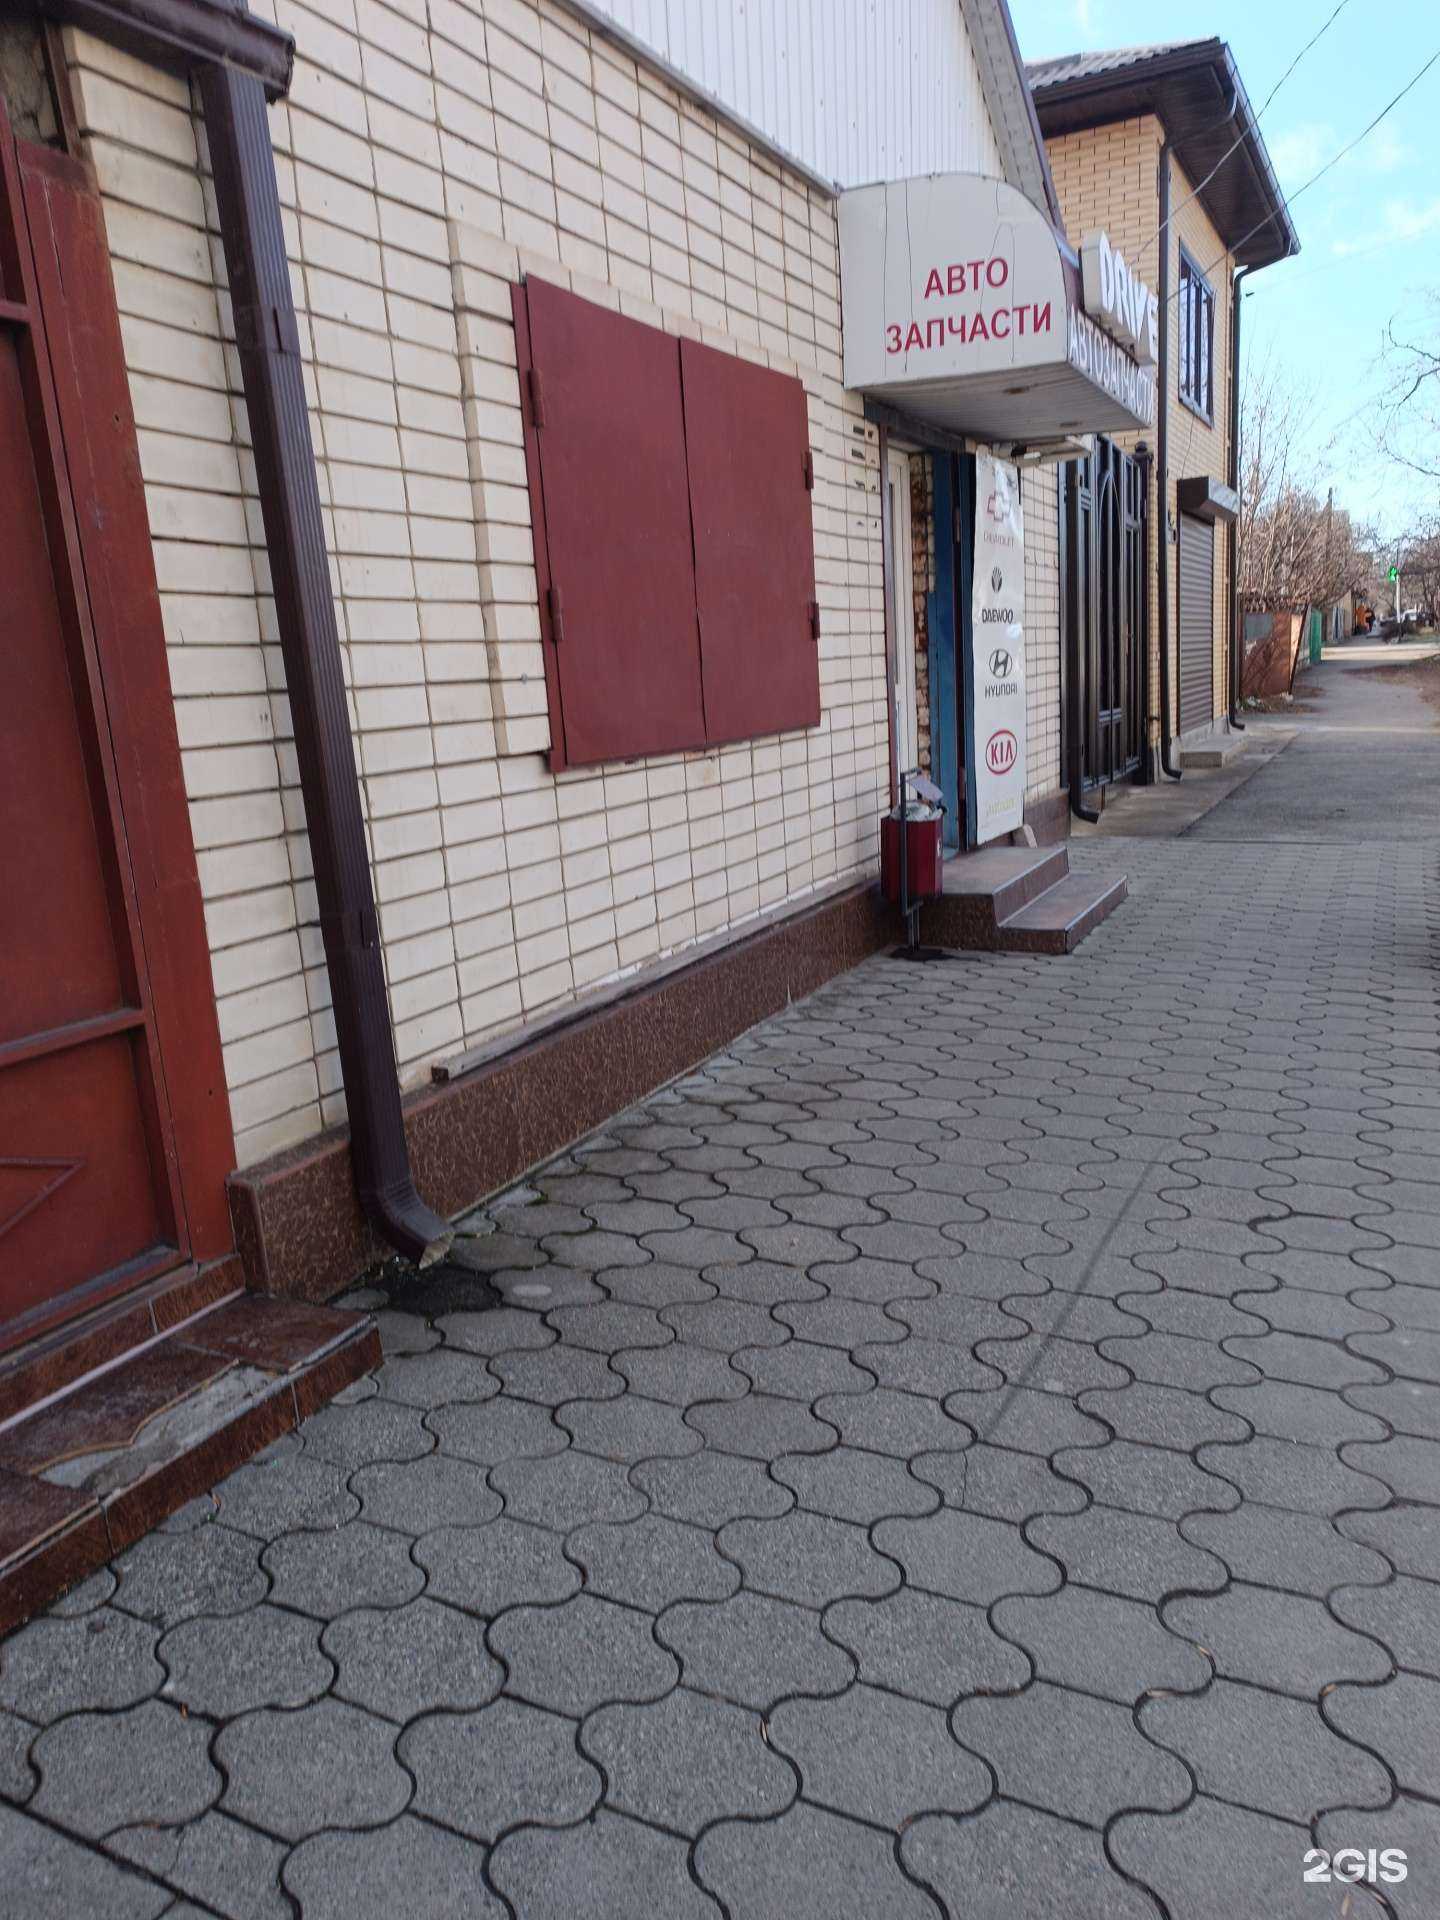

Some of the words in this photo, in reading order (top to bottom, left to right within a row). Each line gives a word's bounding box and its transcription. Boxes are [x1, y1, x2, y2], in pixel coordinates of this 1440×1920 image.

[924, 258, 1008, 299] АВТО
[886, 302, 1051, 354] ЗАПЧАСТИ
[982, 607, 1014, 624] DAEWOO
[984, 682, 1018, 699] HYUNDAI
[991, 740, 1013, 766] KIA
